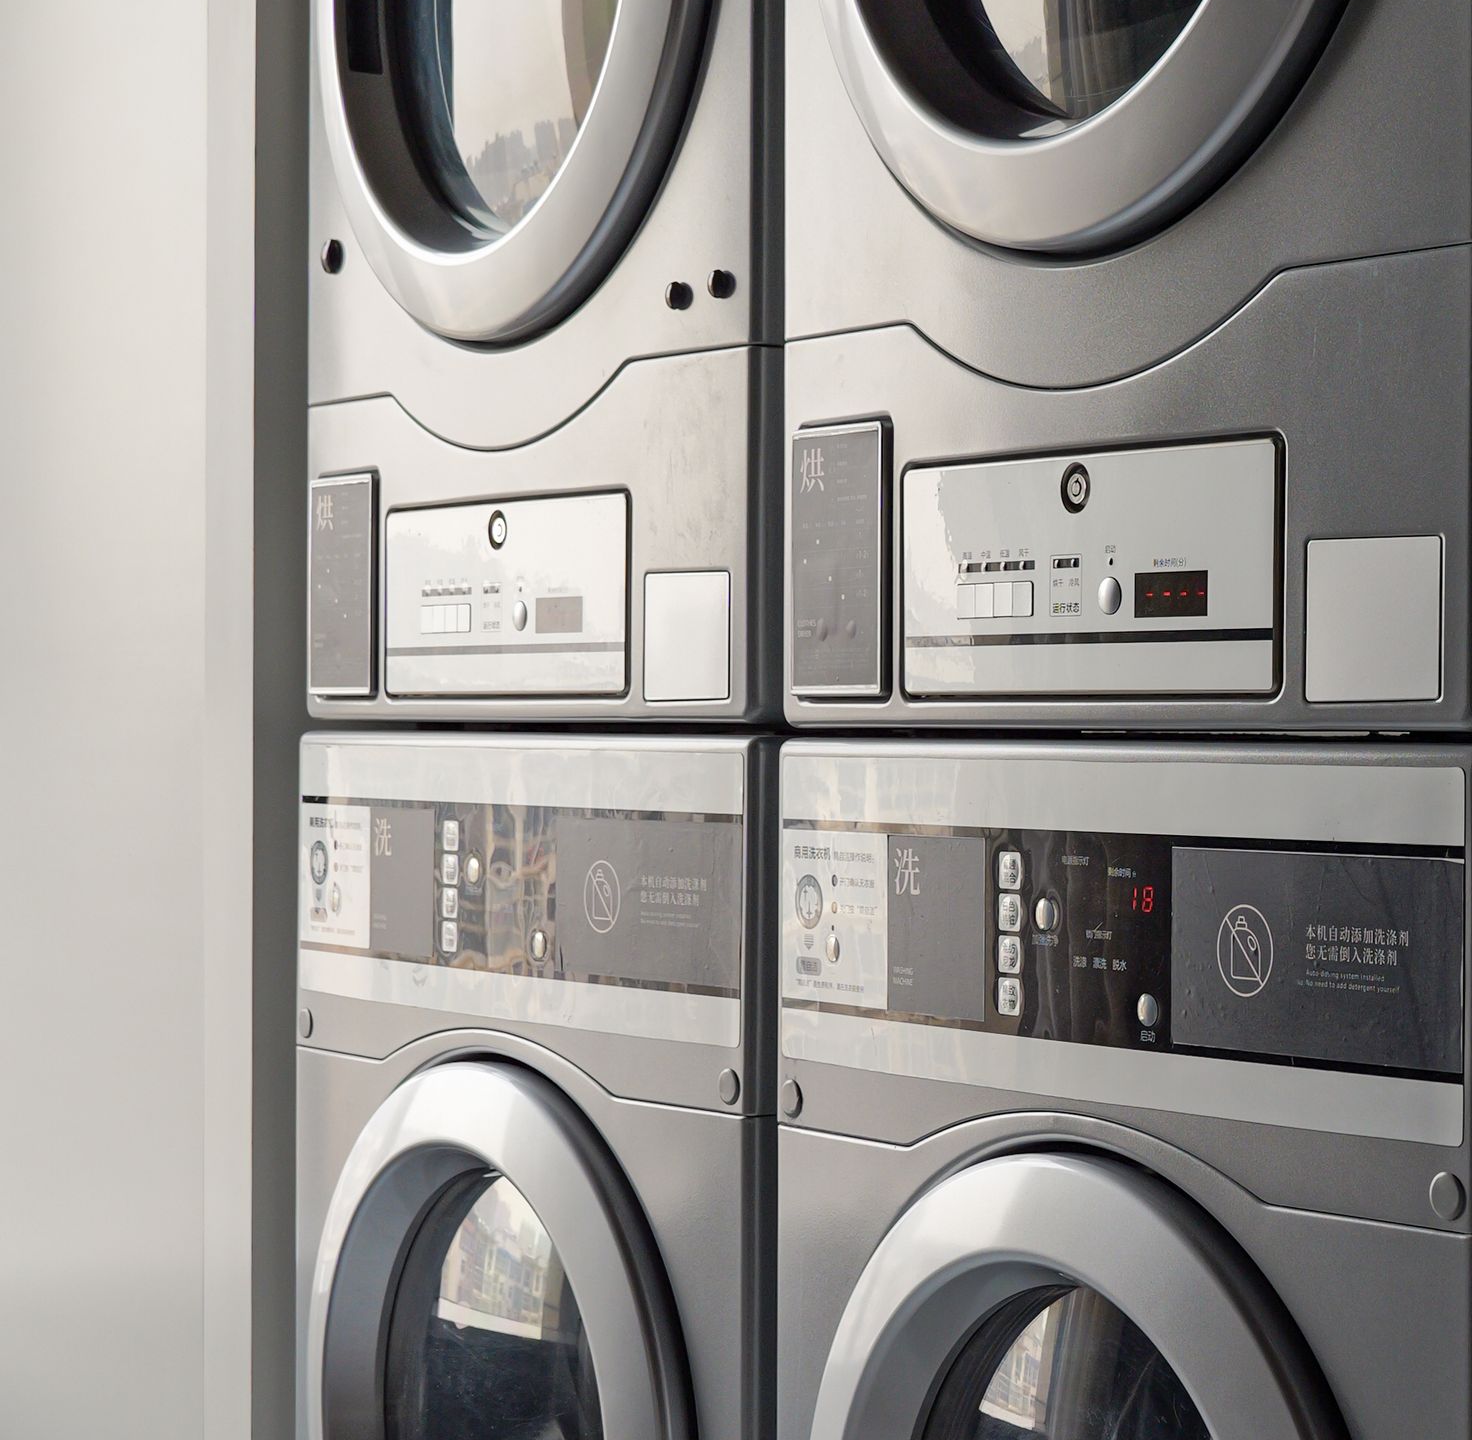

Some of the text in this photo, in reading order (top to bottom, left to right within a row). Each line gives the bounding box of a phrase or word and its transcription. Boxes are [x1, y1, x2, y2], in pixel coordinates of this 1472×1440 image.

[799, 447, 825, 494] 烘
[316, 495, 335, 532] 烘
[1052, 602, 1080, 614] 运行状态
[374, 816, 393, 857] 洗
[893, 848, 921, 896] 洗
[1132, 886, 1154, 913] 18
[1305, 923, 1409, 947] 本机自动添加洗涤剂
[1305, 943, 1397, 966] 您无需倒入洗涤剂
[1340, 972, 1359, 981] system
[1348, 983, 1376, 993] detergent
[1140, 1030, 1156, 1043] 启动
